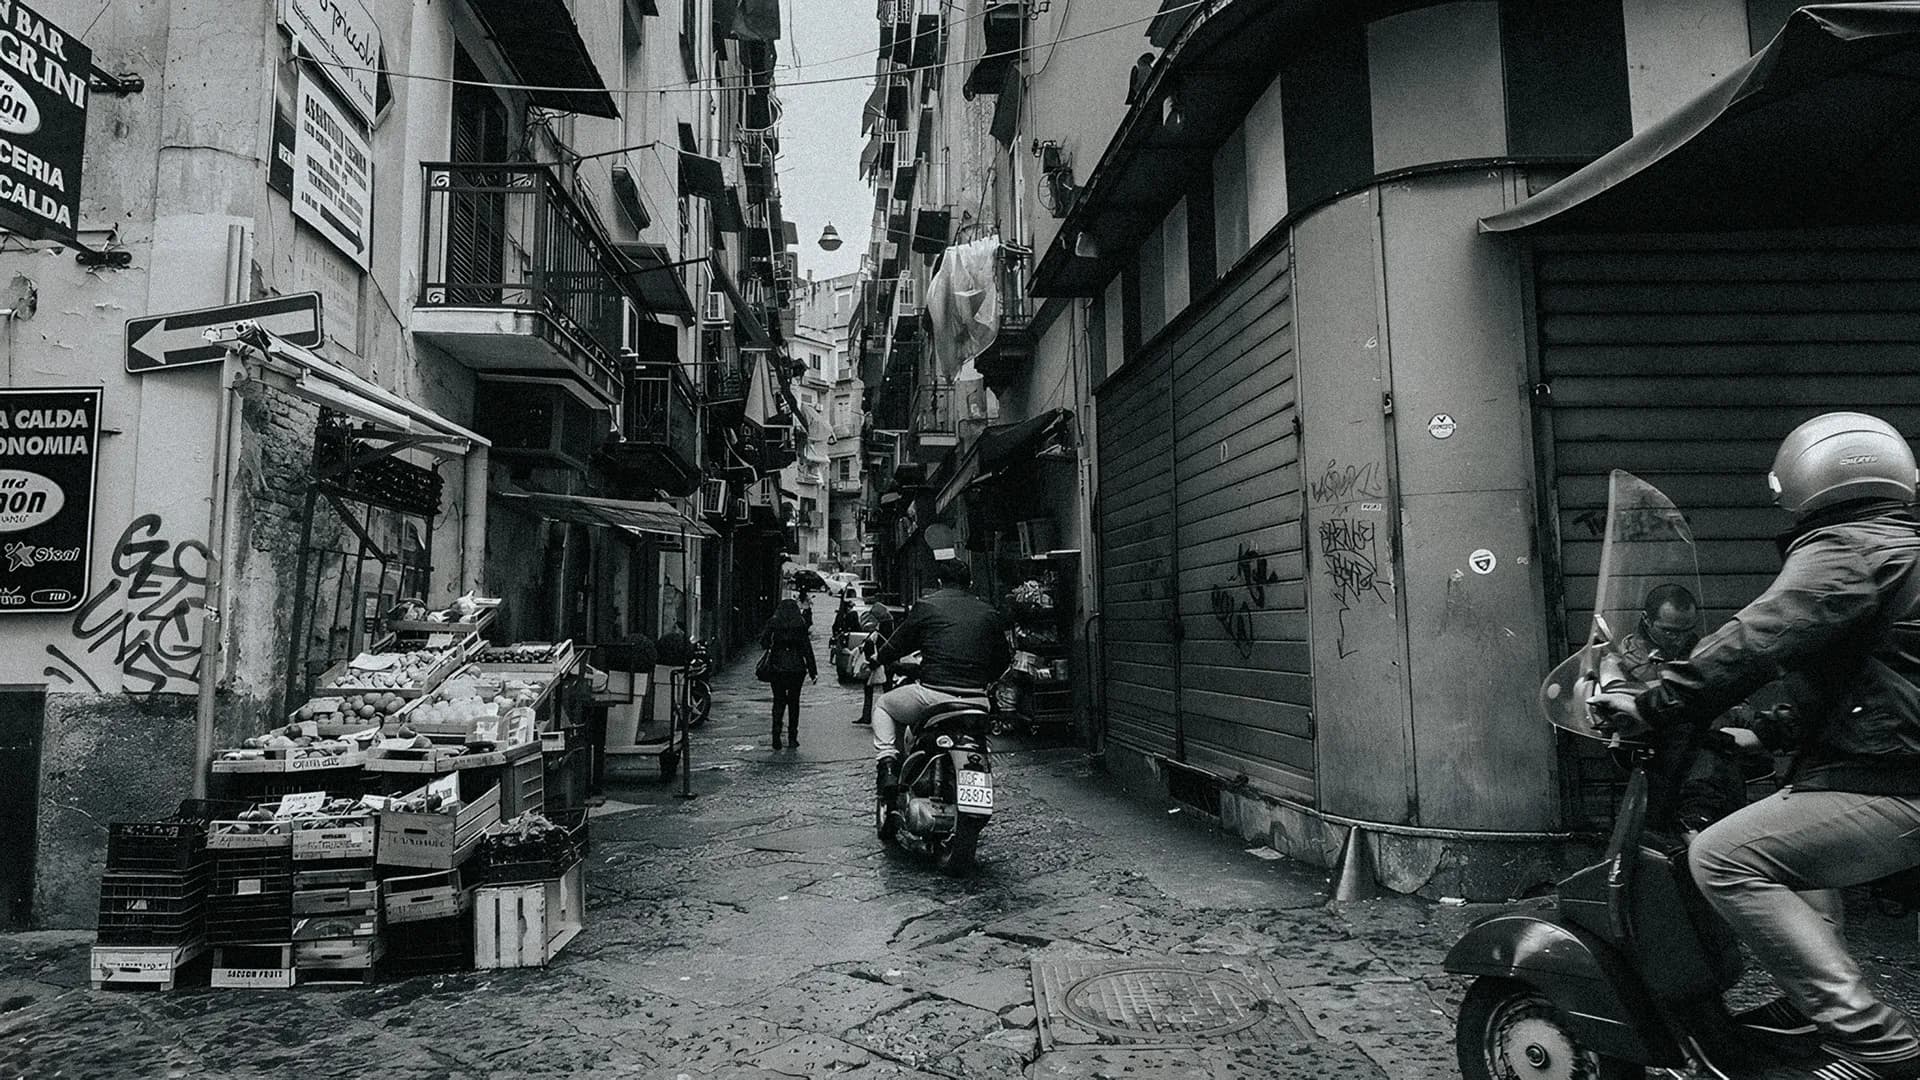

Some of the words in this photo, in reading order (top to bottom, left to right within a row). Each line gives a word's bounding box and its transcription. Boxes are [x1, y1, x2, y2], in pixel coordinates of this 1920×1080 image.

[15, 6, 68, 62] BAR
[0, 139, 65, 192] CERIA
[0, 174, 72, 229] CALDA
[14, 409, 89, 430] CALDA
[34, 547, 81, 562] Sisal
